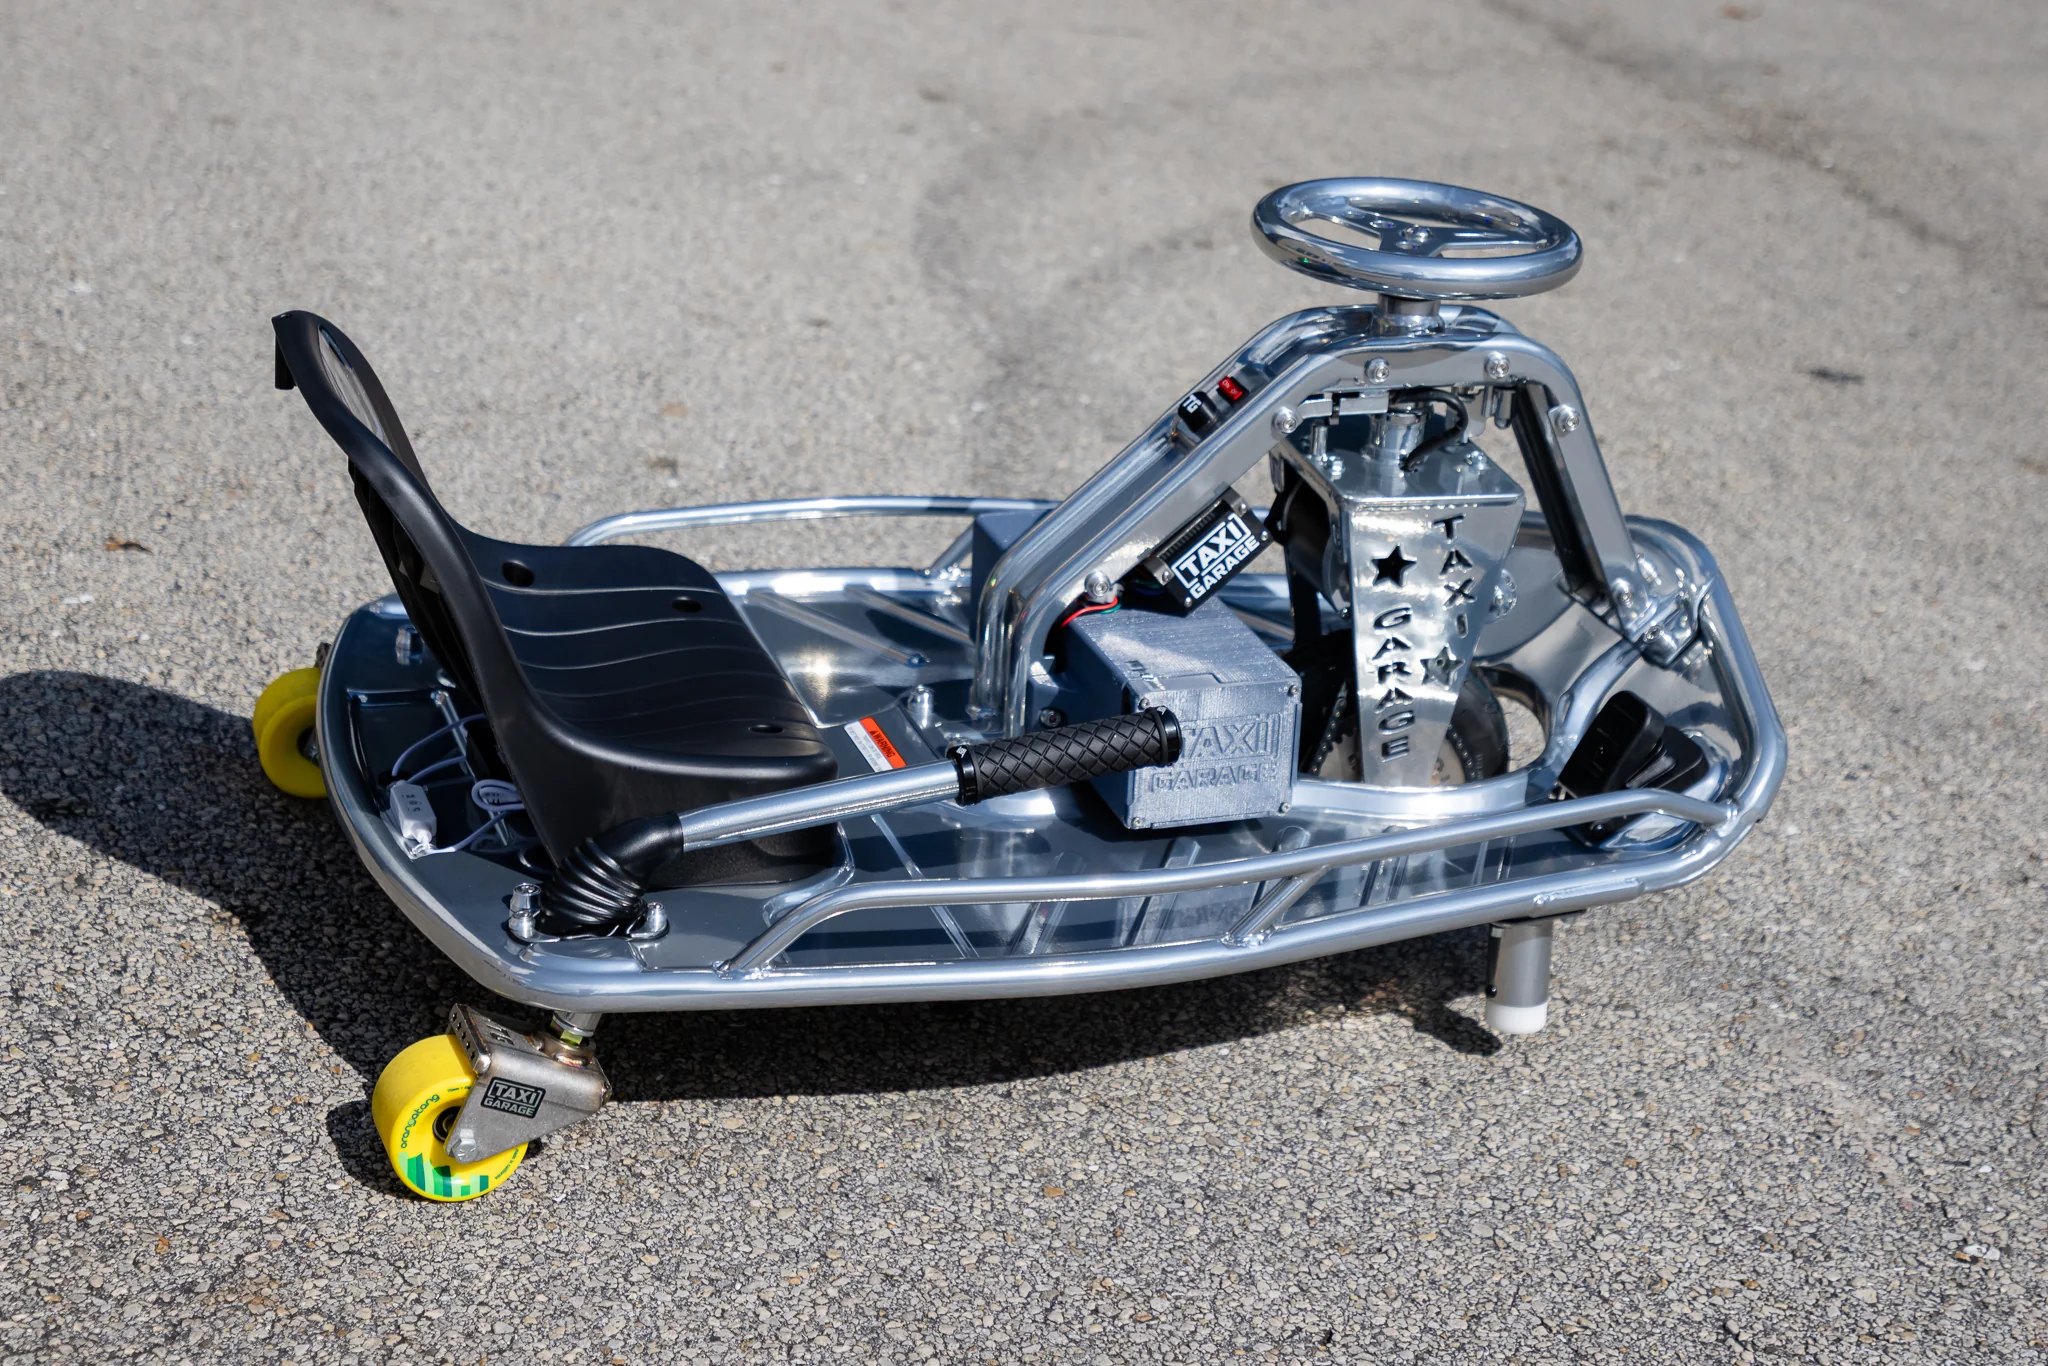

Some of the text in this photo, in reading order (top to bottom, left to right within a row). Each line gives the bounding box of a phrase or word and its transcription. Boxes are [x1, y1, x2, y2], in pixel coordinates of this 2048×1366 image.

[1222, 379, 1231, 389] ON
[1182, 394, 1202, 414] TG
[1179, 521, 1243, 577] TAXI
[1189, 535, 1260, 599] GARAGE
[1433, 514, 1478, 638] TAXI
[1372, 605, 1416, 762] GARAGE
[874, 733, 896, 758] WARNING
[1151, 762, 1279, 792] GARAGE
[483, 1097, 535, 1116] GARAGE
[495, 1083, 537, 1104] TAXI
[401, 1094, 440, 1149] orangatang
